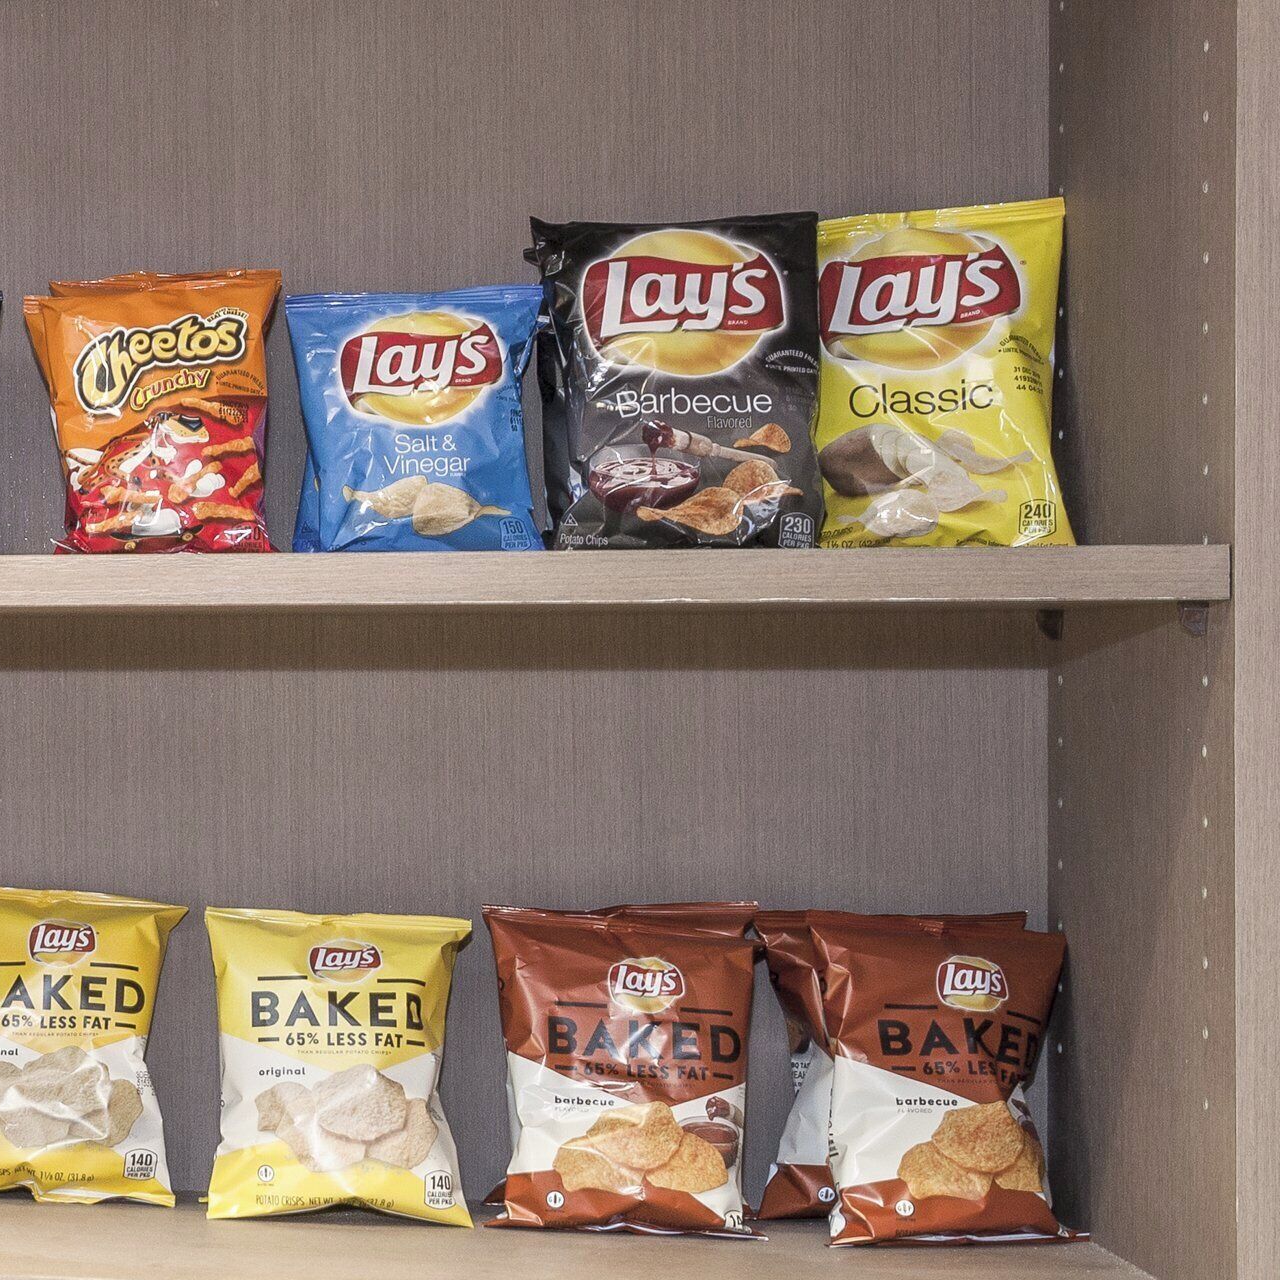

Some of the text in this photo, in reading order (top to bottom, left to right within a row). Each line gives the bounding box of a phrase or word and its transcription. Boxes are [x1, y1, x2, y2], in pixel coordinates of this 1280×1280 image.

[600, 260, 768, 337] Lay's
[829, 253, 1003, 335] Lay's
[75, 315, 247, 414] Cheetos
[352, 332, 490, 396] Lay's
[130, 368, 211, 410] Crunchy
[615, 387, 772, 419] Barbecue
[848, 379, 993, 418] Classic
[707, 415, 752, 429] Flavored
[394, 434, 457, 454] Salt &
[383, 454, 471, 477] Vinegar
[783, 517, 811, 533] 230
[33, 923, 92, 953] Lay's
[315, 946, 374, 972] Lay's
[615, 964, 677, 997] Lay's
[943, 963, 1002, 996] Lay's
[1, 1015, 112, 1030] 65% LESS FAT
[251, 990, 424, 1031] BAKED
[285, 1032, 403, 1048] 65% LESS FAT
[547, 1015, 741, 1063] BAKED
[258, 1067, 306, 1077] original
[554, 1096, 615, 1107] barbecue
[896, 1096, 958, 1107] barbecue
